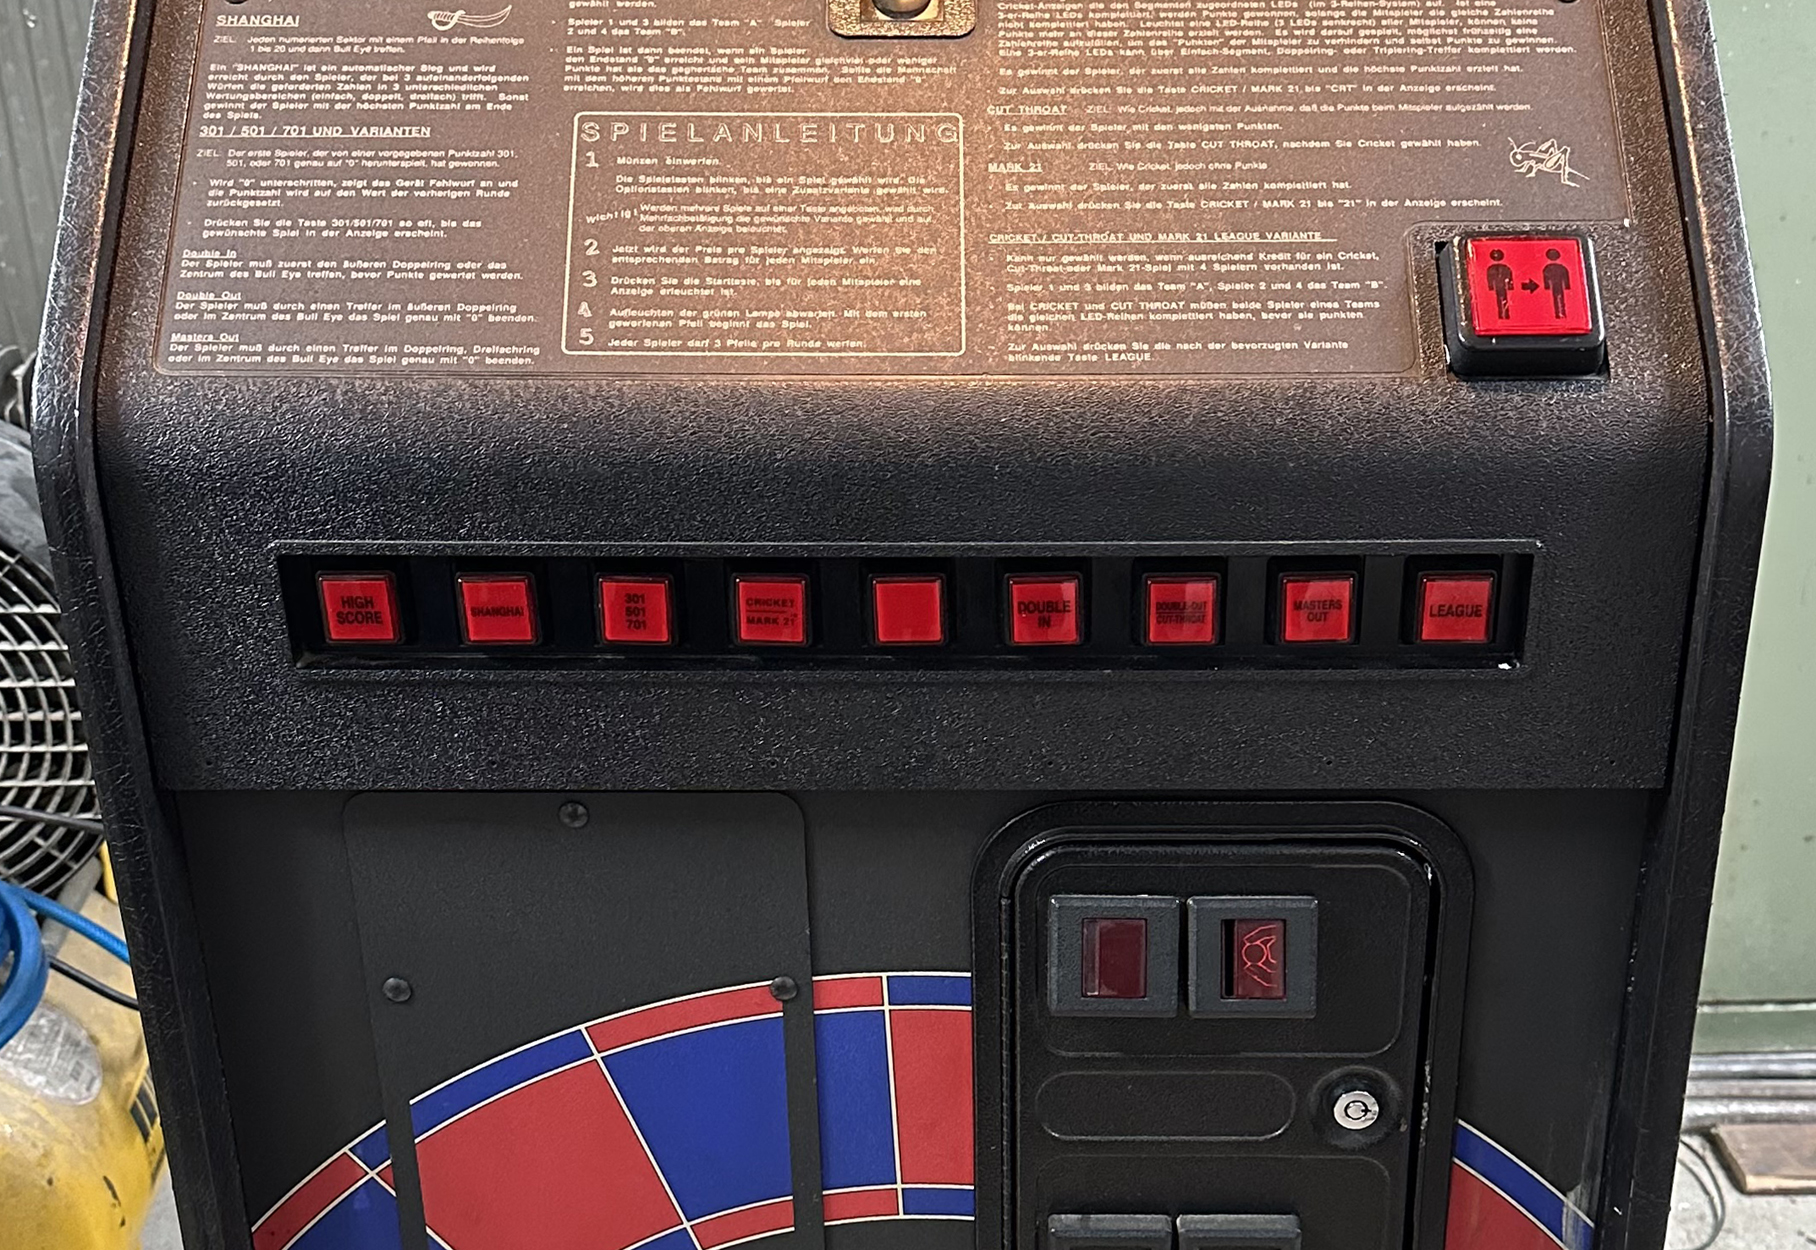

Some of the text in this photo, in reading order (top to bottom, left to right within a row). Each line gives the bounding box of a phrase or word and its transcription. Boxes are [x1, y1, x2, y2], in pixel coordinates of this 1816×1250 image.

[216, 15, 300, 26] SHANGHAI
[987, 105, 1068, 113] CUT THROAT
[200, 126, 223, 136] 301
[241, 126, 264, 136] 501
[283, 126, 305, 136] 701
[313, 126, 342, 136] UND
[351, 126, 431, 136] VARIANTEN
[580, 123, 959, 142] SPIELANLEITUNG
[585, 152, 598, 167] 1
[988, 163, 1043, 171] MARK 21
[202, 229, 266, 238] gewünschte
[273, 229, 299, 238] Spiel
[306, 229, 315, 237] in
[346, 230, 388, 238] Anzeige
[395, 230, 448, 238] erscheint.
[989, 233, 1036, 241] CRICKET
[1052, 233, 1123, 241] CUT-THROAT
[1129, 232, 1152, 241] UND
[1158, 232, 1189, 241] MARK
[1196, 232, 1207, 241] 21
[1215, 232, 1259, 241] LEAGUE
[1266, 232, 1322, 241] VARIANTE
[584, 238, 600, 255] 2
[183, 249, 237, 258] Double In
[181, 259, 199, 267] Der
[206, 260, 242, 269] Spieler
[249, 260, 272, 268] muß
[393, 261, 450, 270] Doppelring
[457, 261, 482, 269] oder
[488, 262, 507, 270] das
[582, 270, 597, 287] 3
[177, 291, 242, 300] Double Out
[577, 302, 592, 317] 4
[170, 333, 240, 342] Masters Out
[578, 328, 594, 344] 5
[341, 595, 374, 609] HIGH
[624, 593, 646, 604] 301
[746, 598, 795, 608] CRICKET
[625, 606, 647, 617] 501
[1017, 600, 1072, 614] DOUBLE
[1293, 599, 1343, 612] MASTERS
[1429, 604, 1483, 618] LEAGUE
[336, 610, 383, 625] SCORE
[470, 606, 525, 618] SHANGHAI
[1307, 611, 1329, 623] OUT
[626, 619, 647, 631] 701
[746, 616, 796, 626] MARK 21
[1038, 615, 1052, 628] IN
